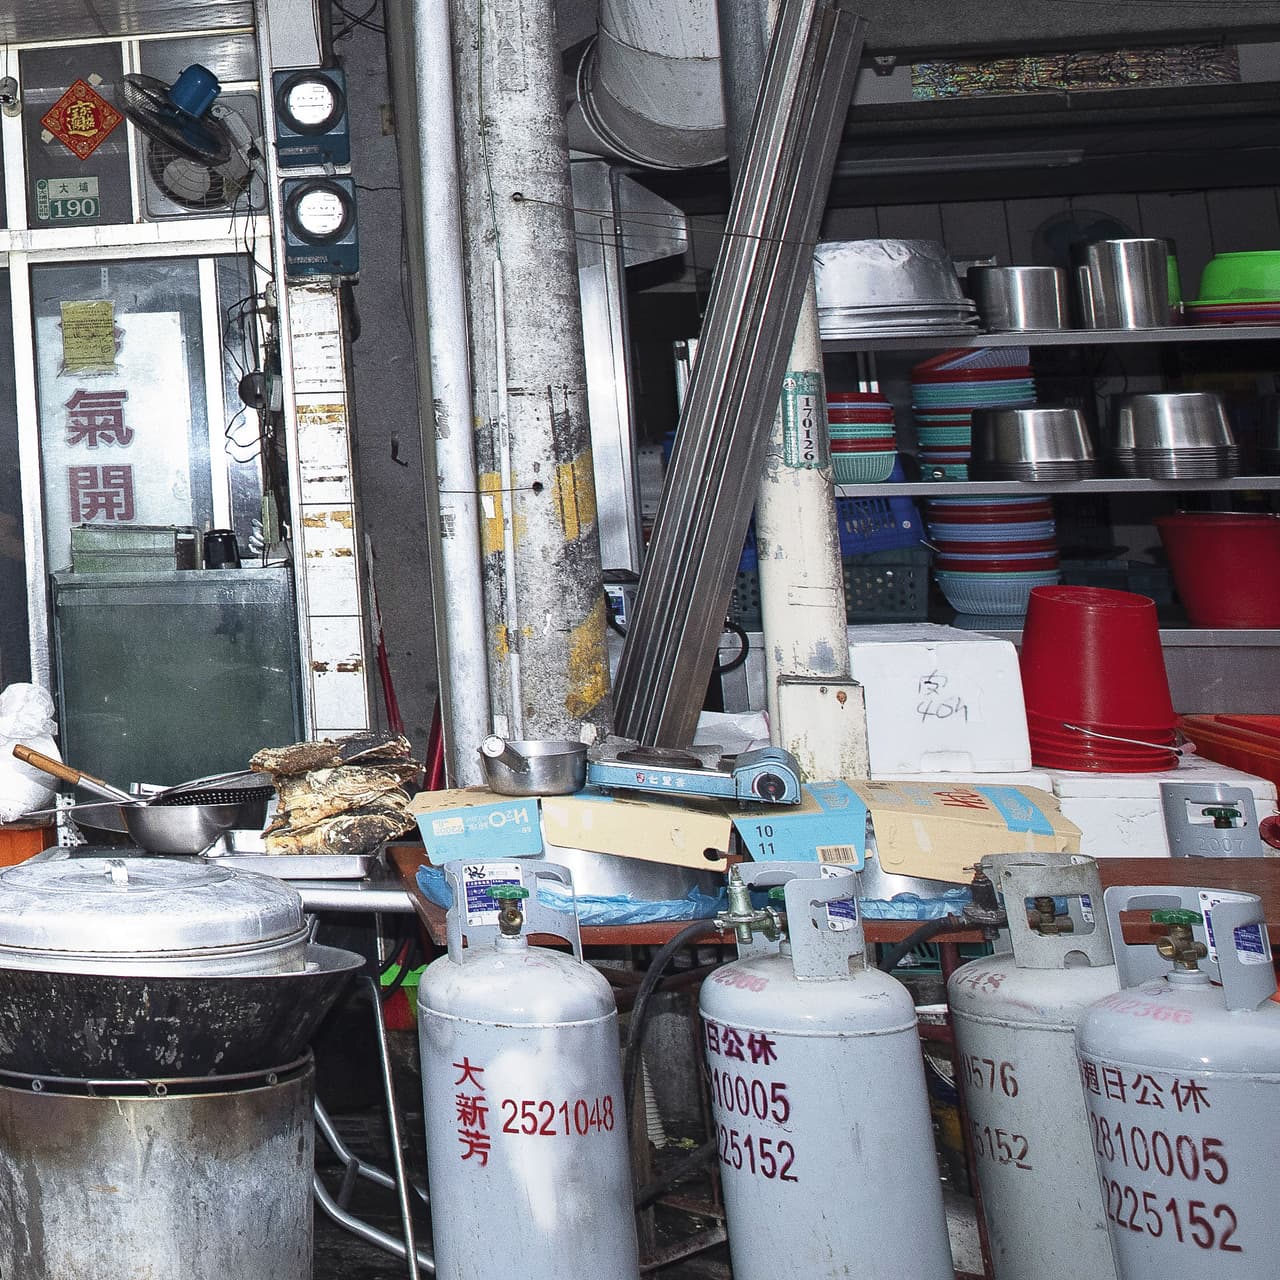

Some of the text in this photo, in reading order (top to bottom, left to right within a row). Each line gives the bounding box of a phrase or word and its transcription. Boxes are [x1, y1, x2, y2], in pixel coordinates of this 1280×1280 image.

[54, 198, 96, 218] 190
[802, 397, 815, 461] 170126
[756, 825, 774, 838] 10
[759, 842, 775, 855] 11
[706, 1021, 778, 1065] 日公休
[452, 1056, 491, 1167] 大新芳
[501, 1095, 614, 1136] 2521048
[711, 1067, 790, 1124] 10005
[1091, 1111, 1229, 1185] 2810005
[1103, 1176, 1242, 1253] 2225152
